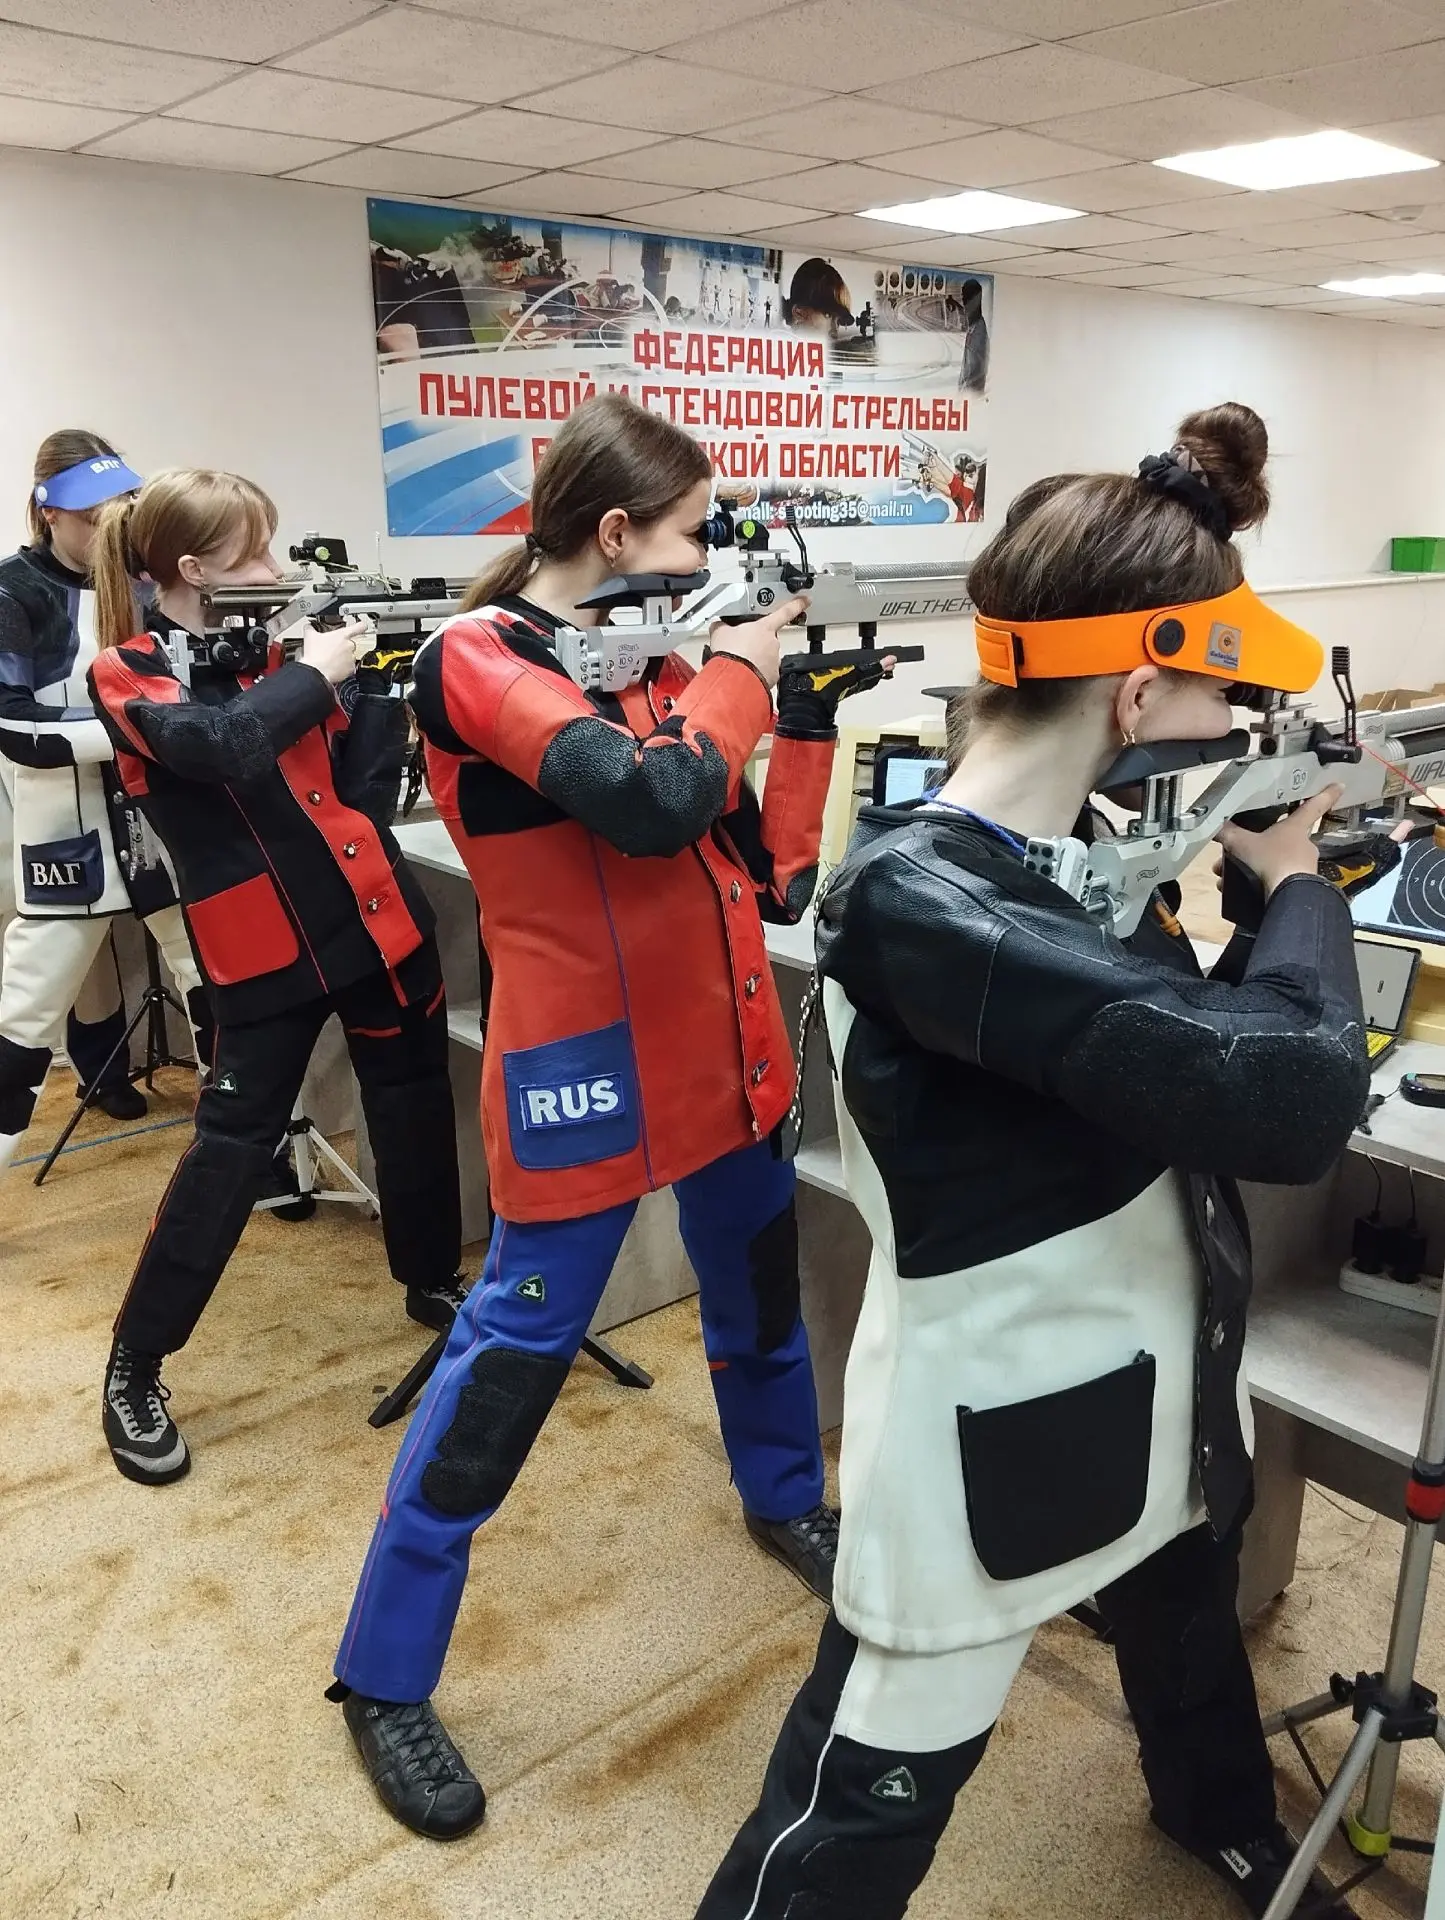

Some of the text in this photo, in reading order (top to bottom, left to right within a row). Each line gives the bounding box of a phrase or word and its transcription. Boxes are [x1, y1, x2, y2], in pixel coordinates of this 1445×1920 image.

[633, 328, 824, 381] ФЕДЕРАЦИЯ
[419, 371, 968, 431] ПУЛЕВОЙ СТЕНДОВОЙ СТРЕЛЬБЫ
[779, 442, 901, 478] ОБЛАСТИ
[778, 500, 914, 523] sooting35@mail.ru
[879, 597, 974, 617] WALTHER
[526, 1079, 619, 1124] RUS
